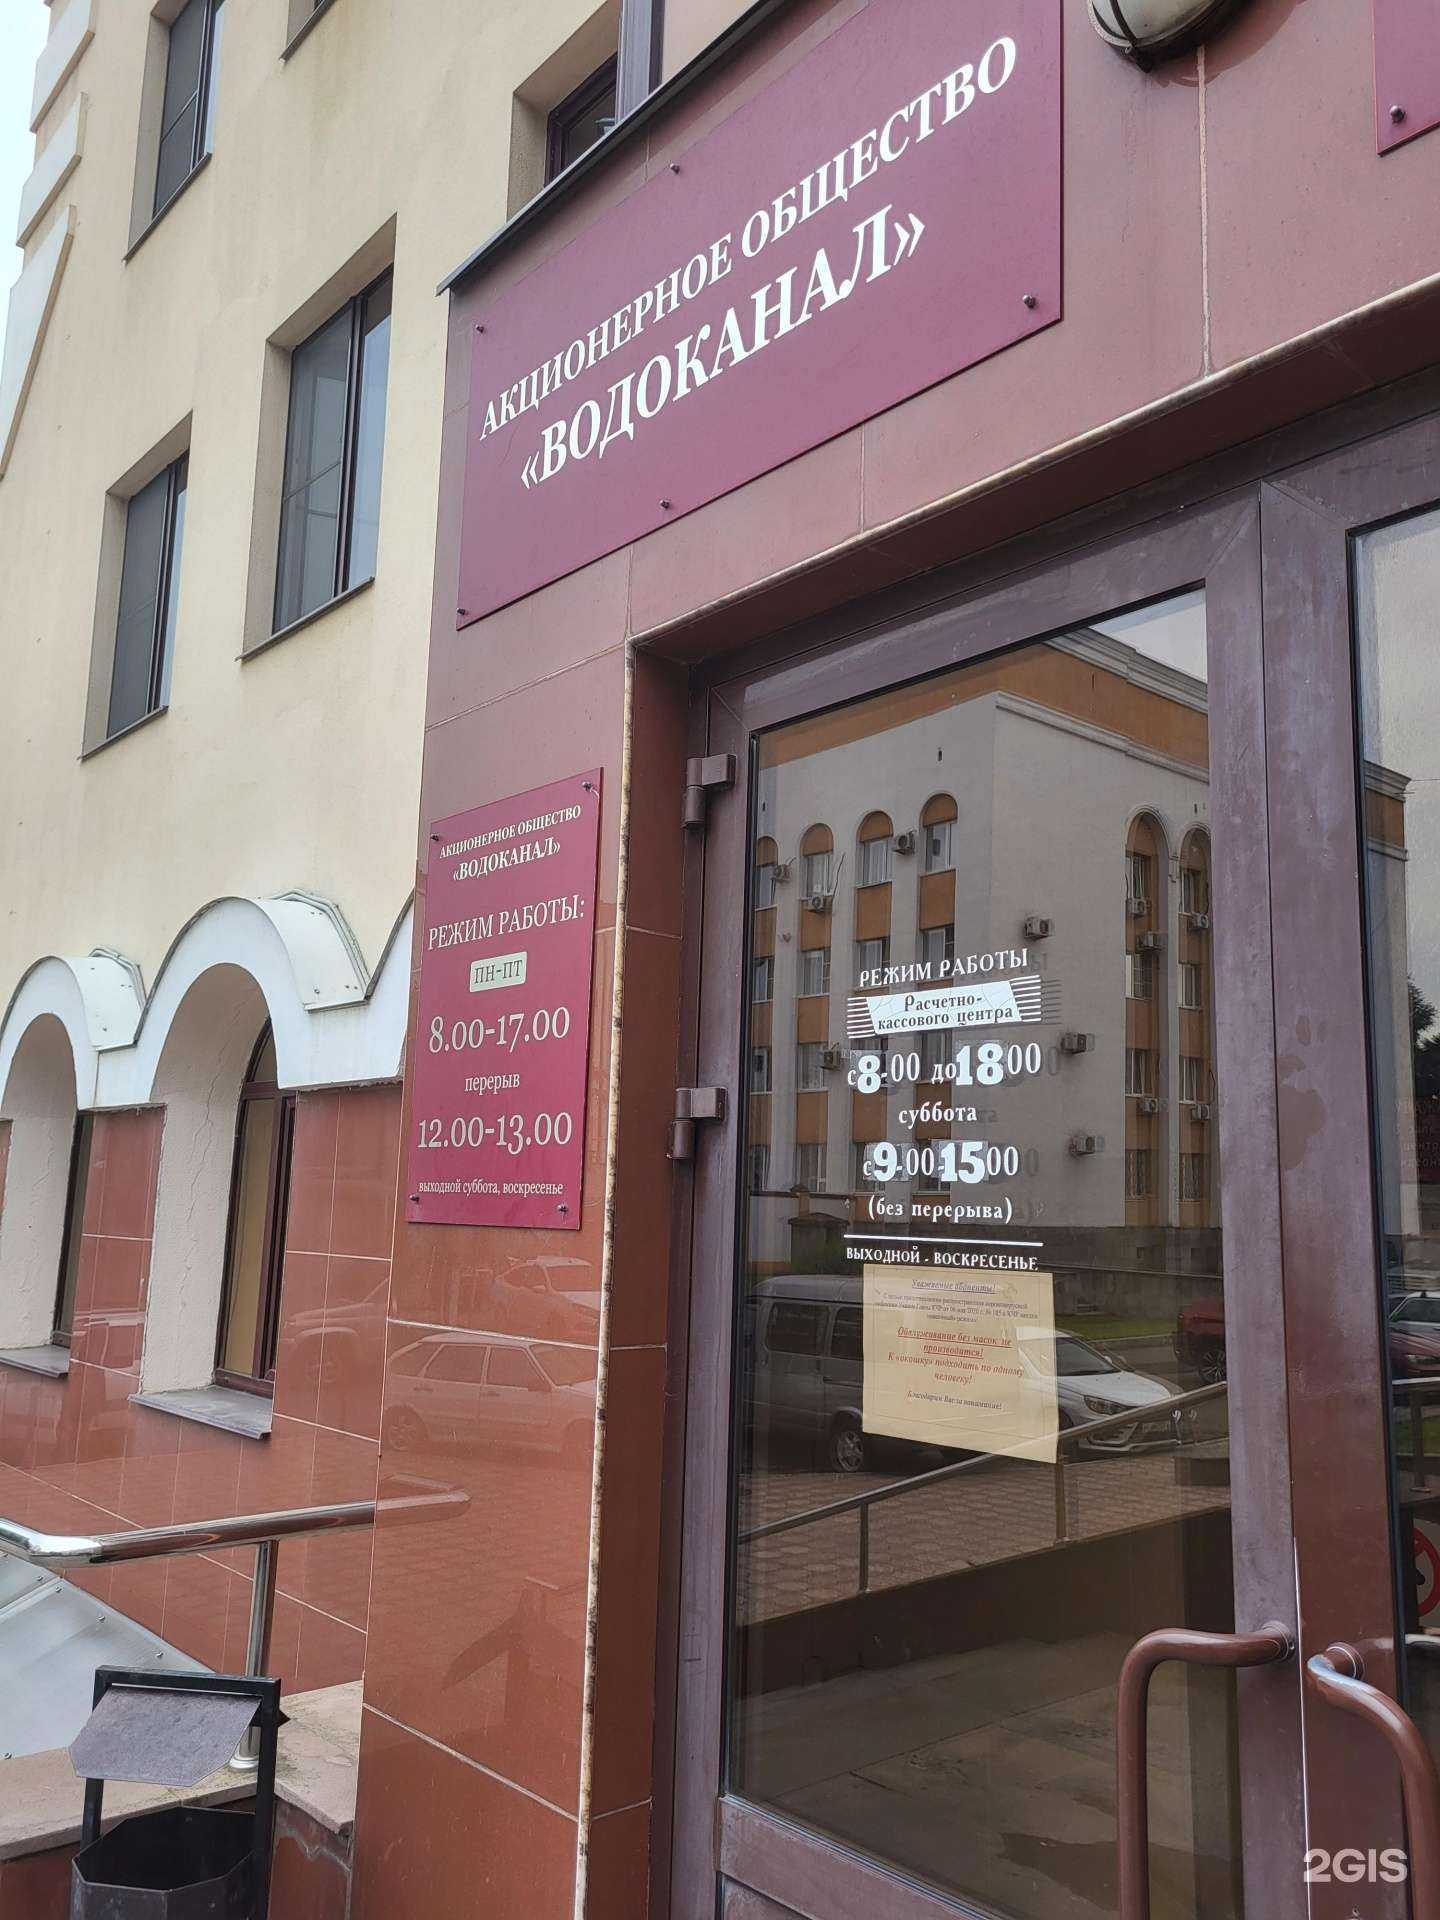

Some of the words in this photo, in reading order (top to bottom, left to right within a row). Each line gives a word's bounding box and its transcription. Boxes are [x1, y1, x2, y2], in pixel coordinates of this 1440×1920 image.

[479, 233, 733, 441] АКЦИОНЕРНОЕ
[741, 36, 1017, 258] ОБЩЕСТВО
[520, 203, 926, 490] «ВОДОКАНАЛ»
[440, 825, 516, 859] АКЦИОНЕРНОЕ
[518, 804, 582, 834] ОБЩЕСТВО
[453, 837, 561, 881] «ВОДОКАНАЛ»
[428, 913, 494, 951] РЕЖИМ
[498, 894, 585, 935] РАБОТЫ:
[474, 959, 523, 984] ПН-ПТ
[860, 960, 931, 987] РЕЖИМ
[939, 948, 1028, 978] РАБОТЫ
[878, 1013, 949, 1030] кассового
[957, 1007, 1013, 1026] центра
[904, 994, 982, 1012] Расчетно-
[429, 1006, 571, 1054] 8.00-17.00
[465, 1073, 520, 1095] перерыв
[898, 1101, 977, 1129] суббота
[418, 1112, 573, 1155] 12.00-13.00
[418, 1179, 461, 1194] выходной
[462, 1178, 501, 1197] суббота,
[502, 1182, 564, 1197] воскресенье
[868, 1195, 903, 1221] (без
[911, 1196, 1013, 1224] перерыва)
[846, 1246, 920, 1264] ВЫХОДНОЙ
[934, 1252, 1039, 1271] ВОСКРЕСЕНЬЕ
